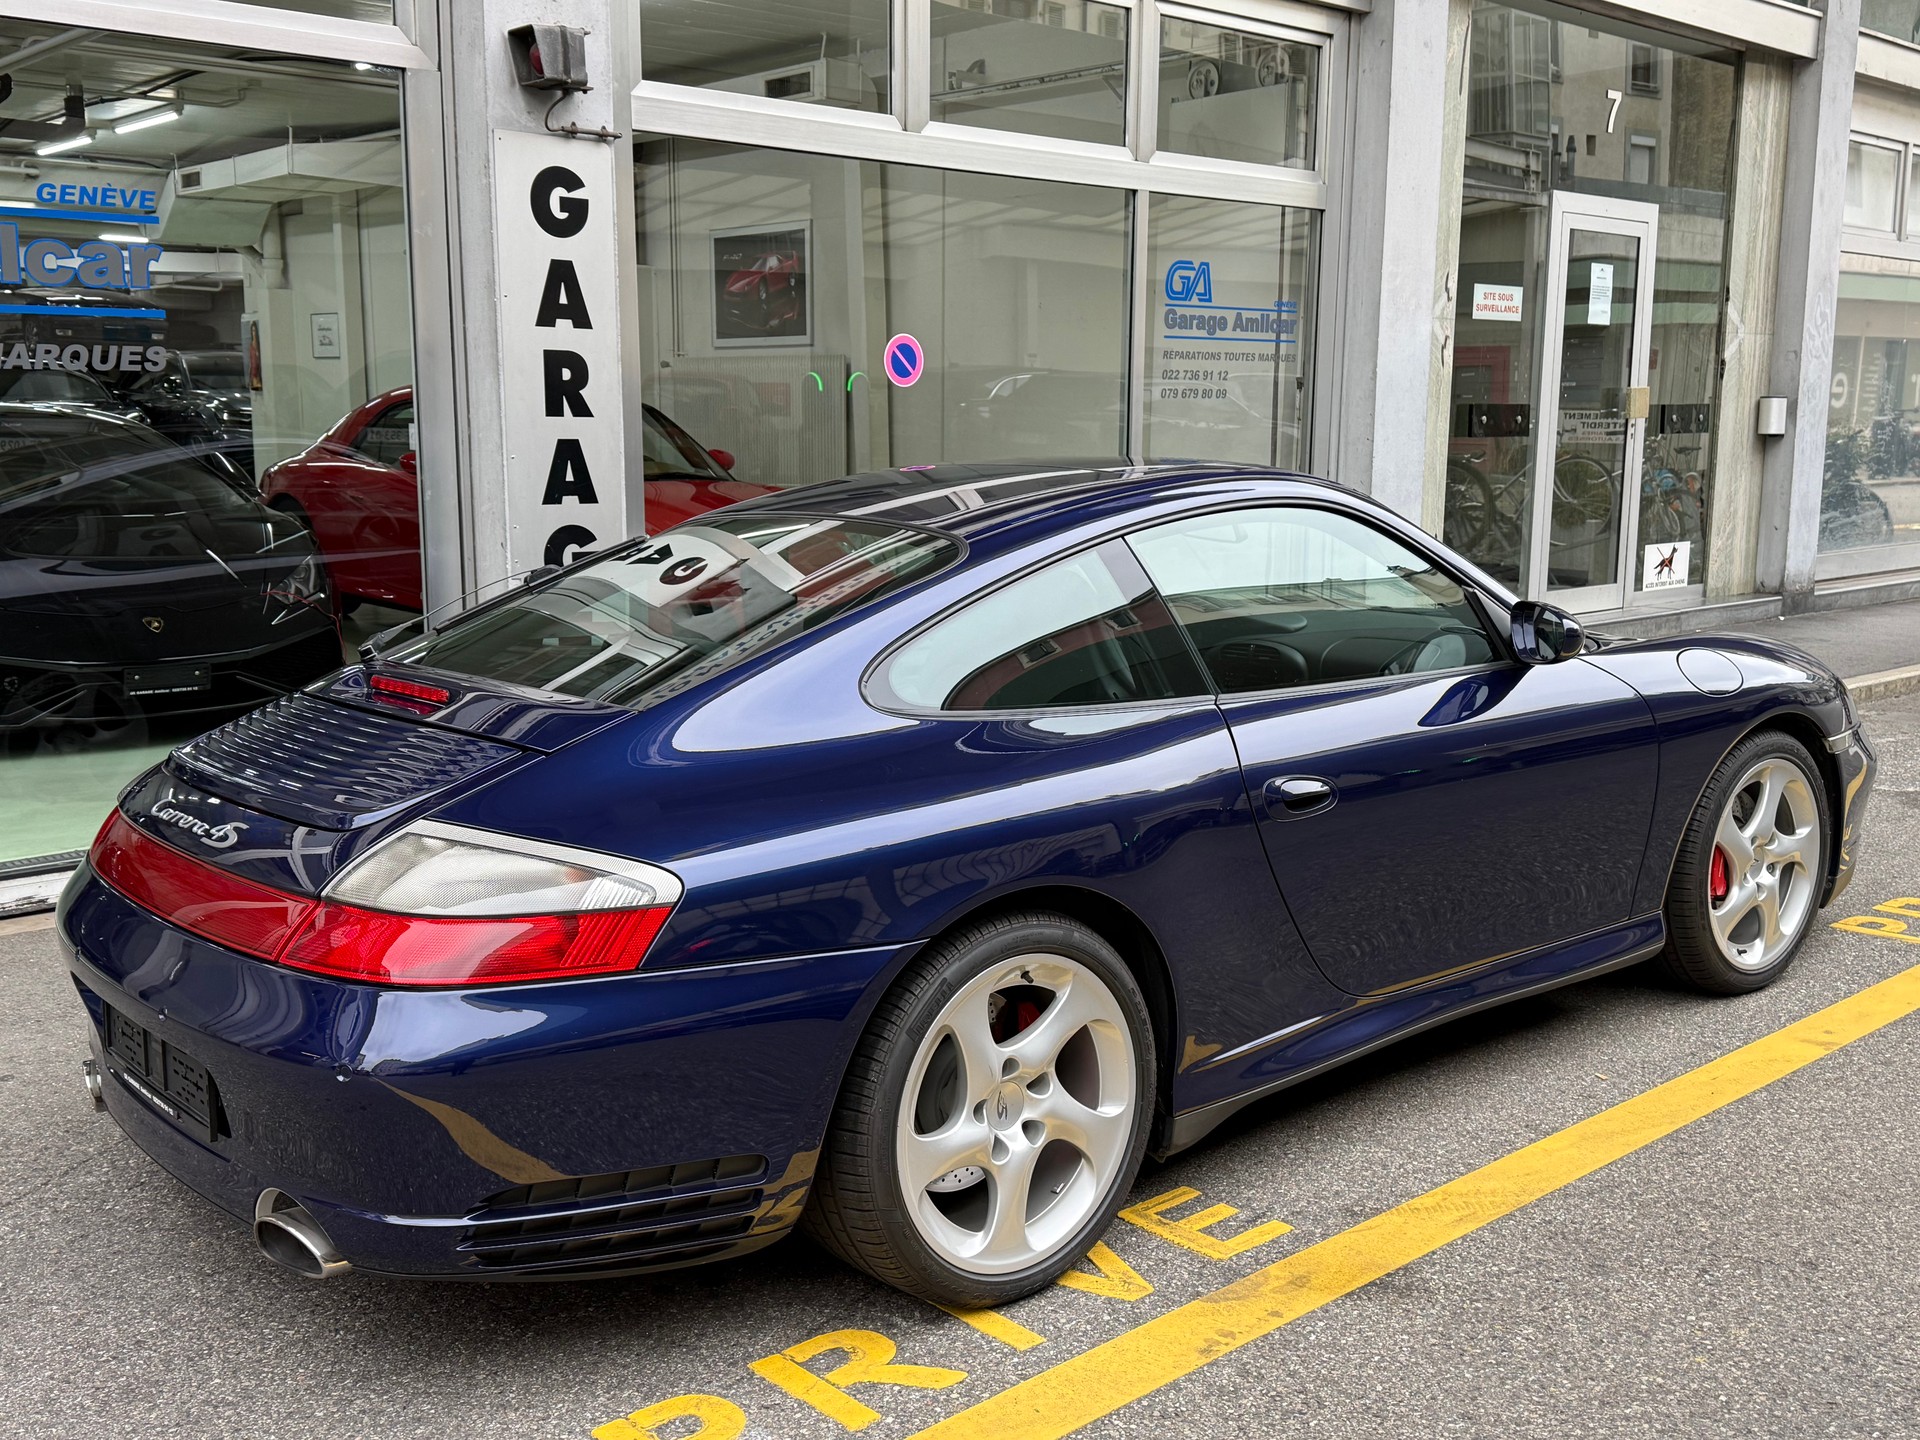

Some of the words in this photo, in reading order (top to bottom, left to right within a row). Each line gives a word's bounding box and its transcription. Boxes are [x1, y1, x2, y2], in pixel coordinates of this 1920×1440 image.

[1606, 89, 1623, 134] 7
[36, 182, 156, 210] GENÈVE
[1483, 292, 1497, 301] SITE
[1498, 293, 1514, 302] SOUS
[1475, 303, 1520, 314] SURVEILLANCE
[1164, 308, 1228, 336] Garage
[1232, 311, 1297, 335] Amilcar
[0, 342, 167, 372] ARQUES
[1224, 351, 1256, 362] TOUTES
[1161, 369, 1180, 381] 022
[1183, 369, 1200, 381] 736
[1203, 370, 1214, 381] 91
[1217, 370, 1229, 382] 12
[1160, 388, 1179, 399] 079
[1181, 388, 1199, 399] 679
[1201, 388, 1213, 399] 80
[1215, 388, 1228, 399] 09
[151, 797, 210, 836] Carrera
